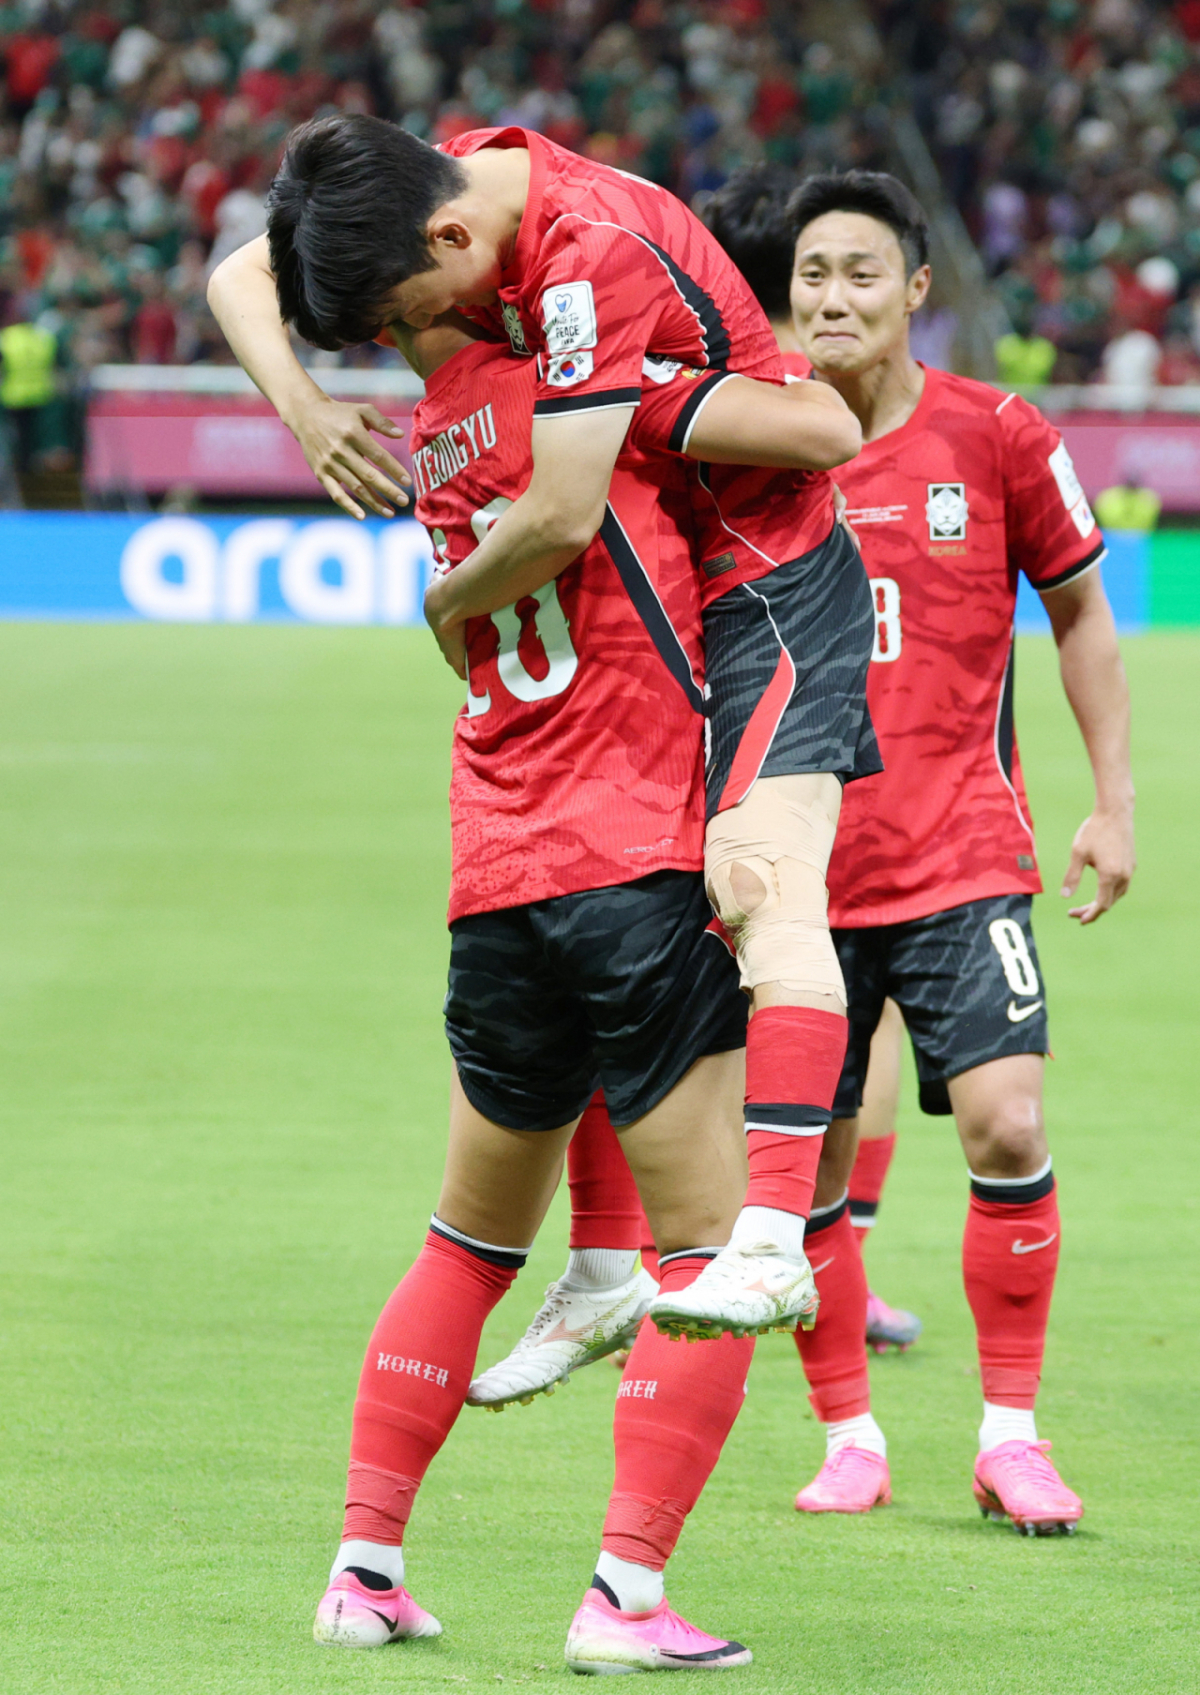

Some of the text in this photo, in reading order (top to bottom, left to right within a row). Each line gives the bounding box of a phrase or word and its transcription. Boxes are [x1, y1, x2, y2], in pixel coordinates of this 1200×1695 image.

[555, 324, 580, 339] PEACE
[411, 402, 497, 500] YEONGYU
[928, 545, 968, 557] KOREA
[868, 577, 903, 663] 8
[988, 918, 1039, 996] 8
[376, 1352, 449, 1388] KOREA
[617, 1379, 658, 1400] OREA
